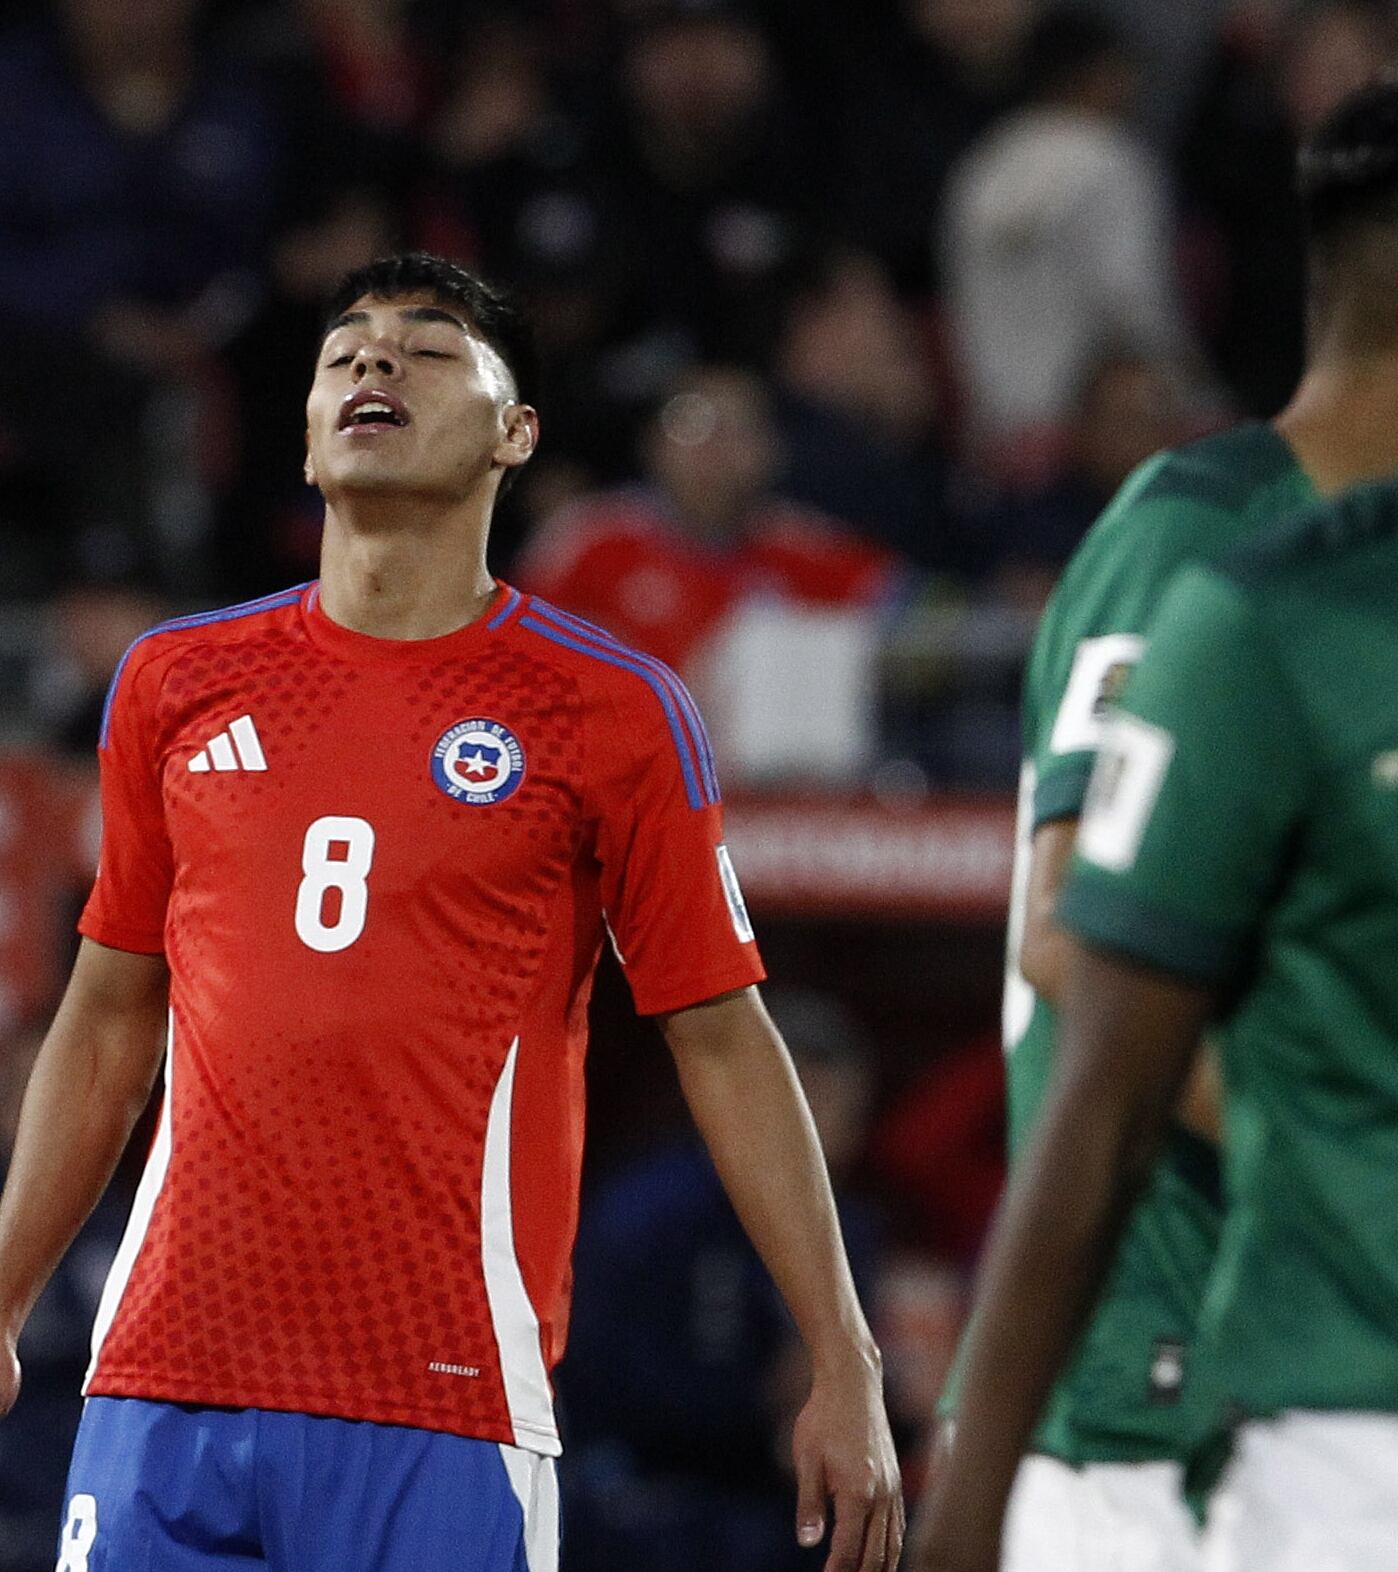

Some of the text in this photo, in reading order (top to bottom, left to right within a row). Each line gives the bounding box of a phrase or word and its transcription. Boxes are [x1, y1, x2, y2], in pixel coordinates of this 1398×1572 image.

[491, 724, 505, 737] DE
[466, 793, 495, 803] CHILE
[295, 815, 375, 952] 8
[55, 1494, 97, 1572] 8
